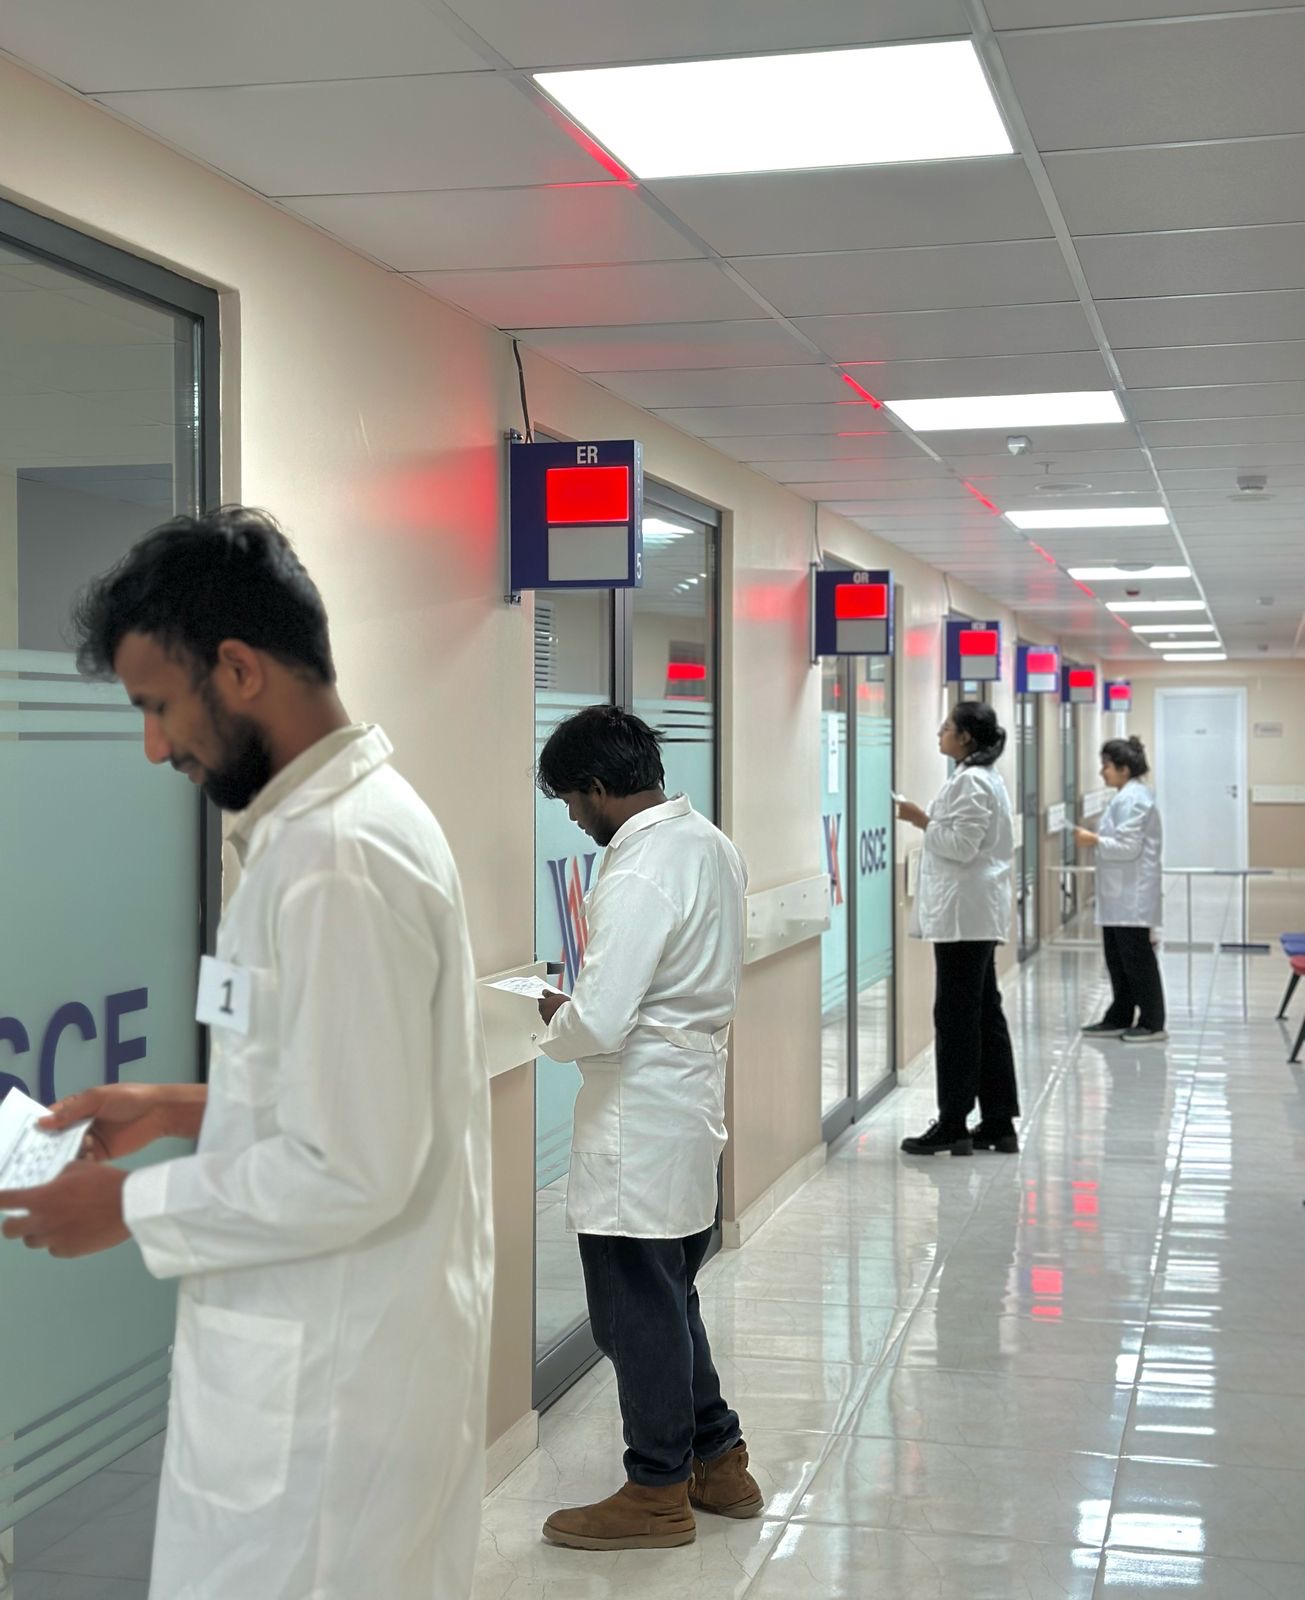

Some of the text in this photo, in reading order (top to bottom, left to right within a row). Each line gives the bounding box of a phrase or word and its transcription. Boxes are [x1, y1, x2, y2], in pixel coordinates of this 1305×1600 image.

[577, 446, 598, 464] ER
[636, 552, 642, 579] 5
[853, 572, 870, 584] OR
[860, 827, 886, 875] OSCE
[218, 978, 234, 1015] 1
